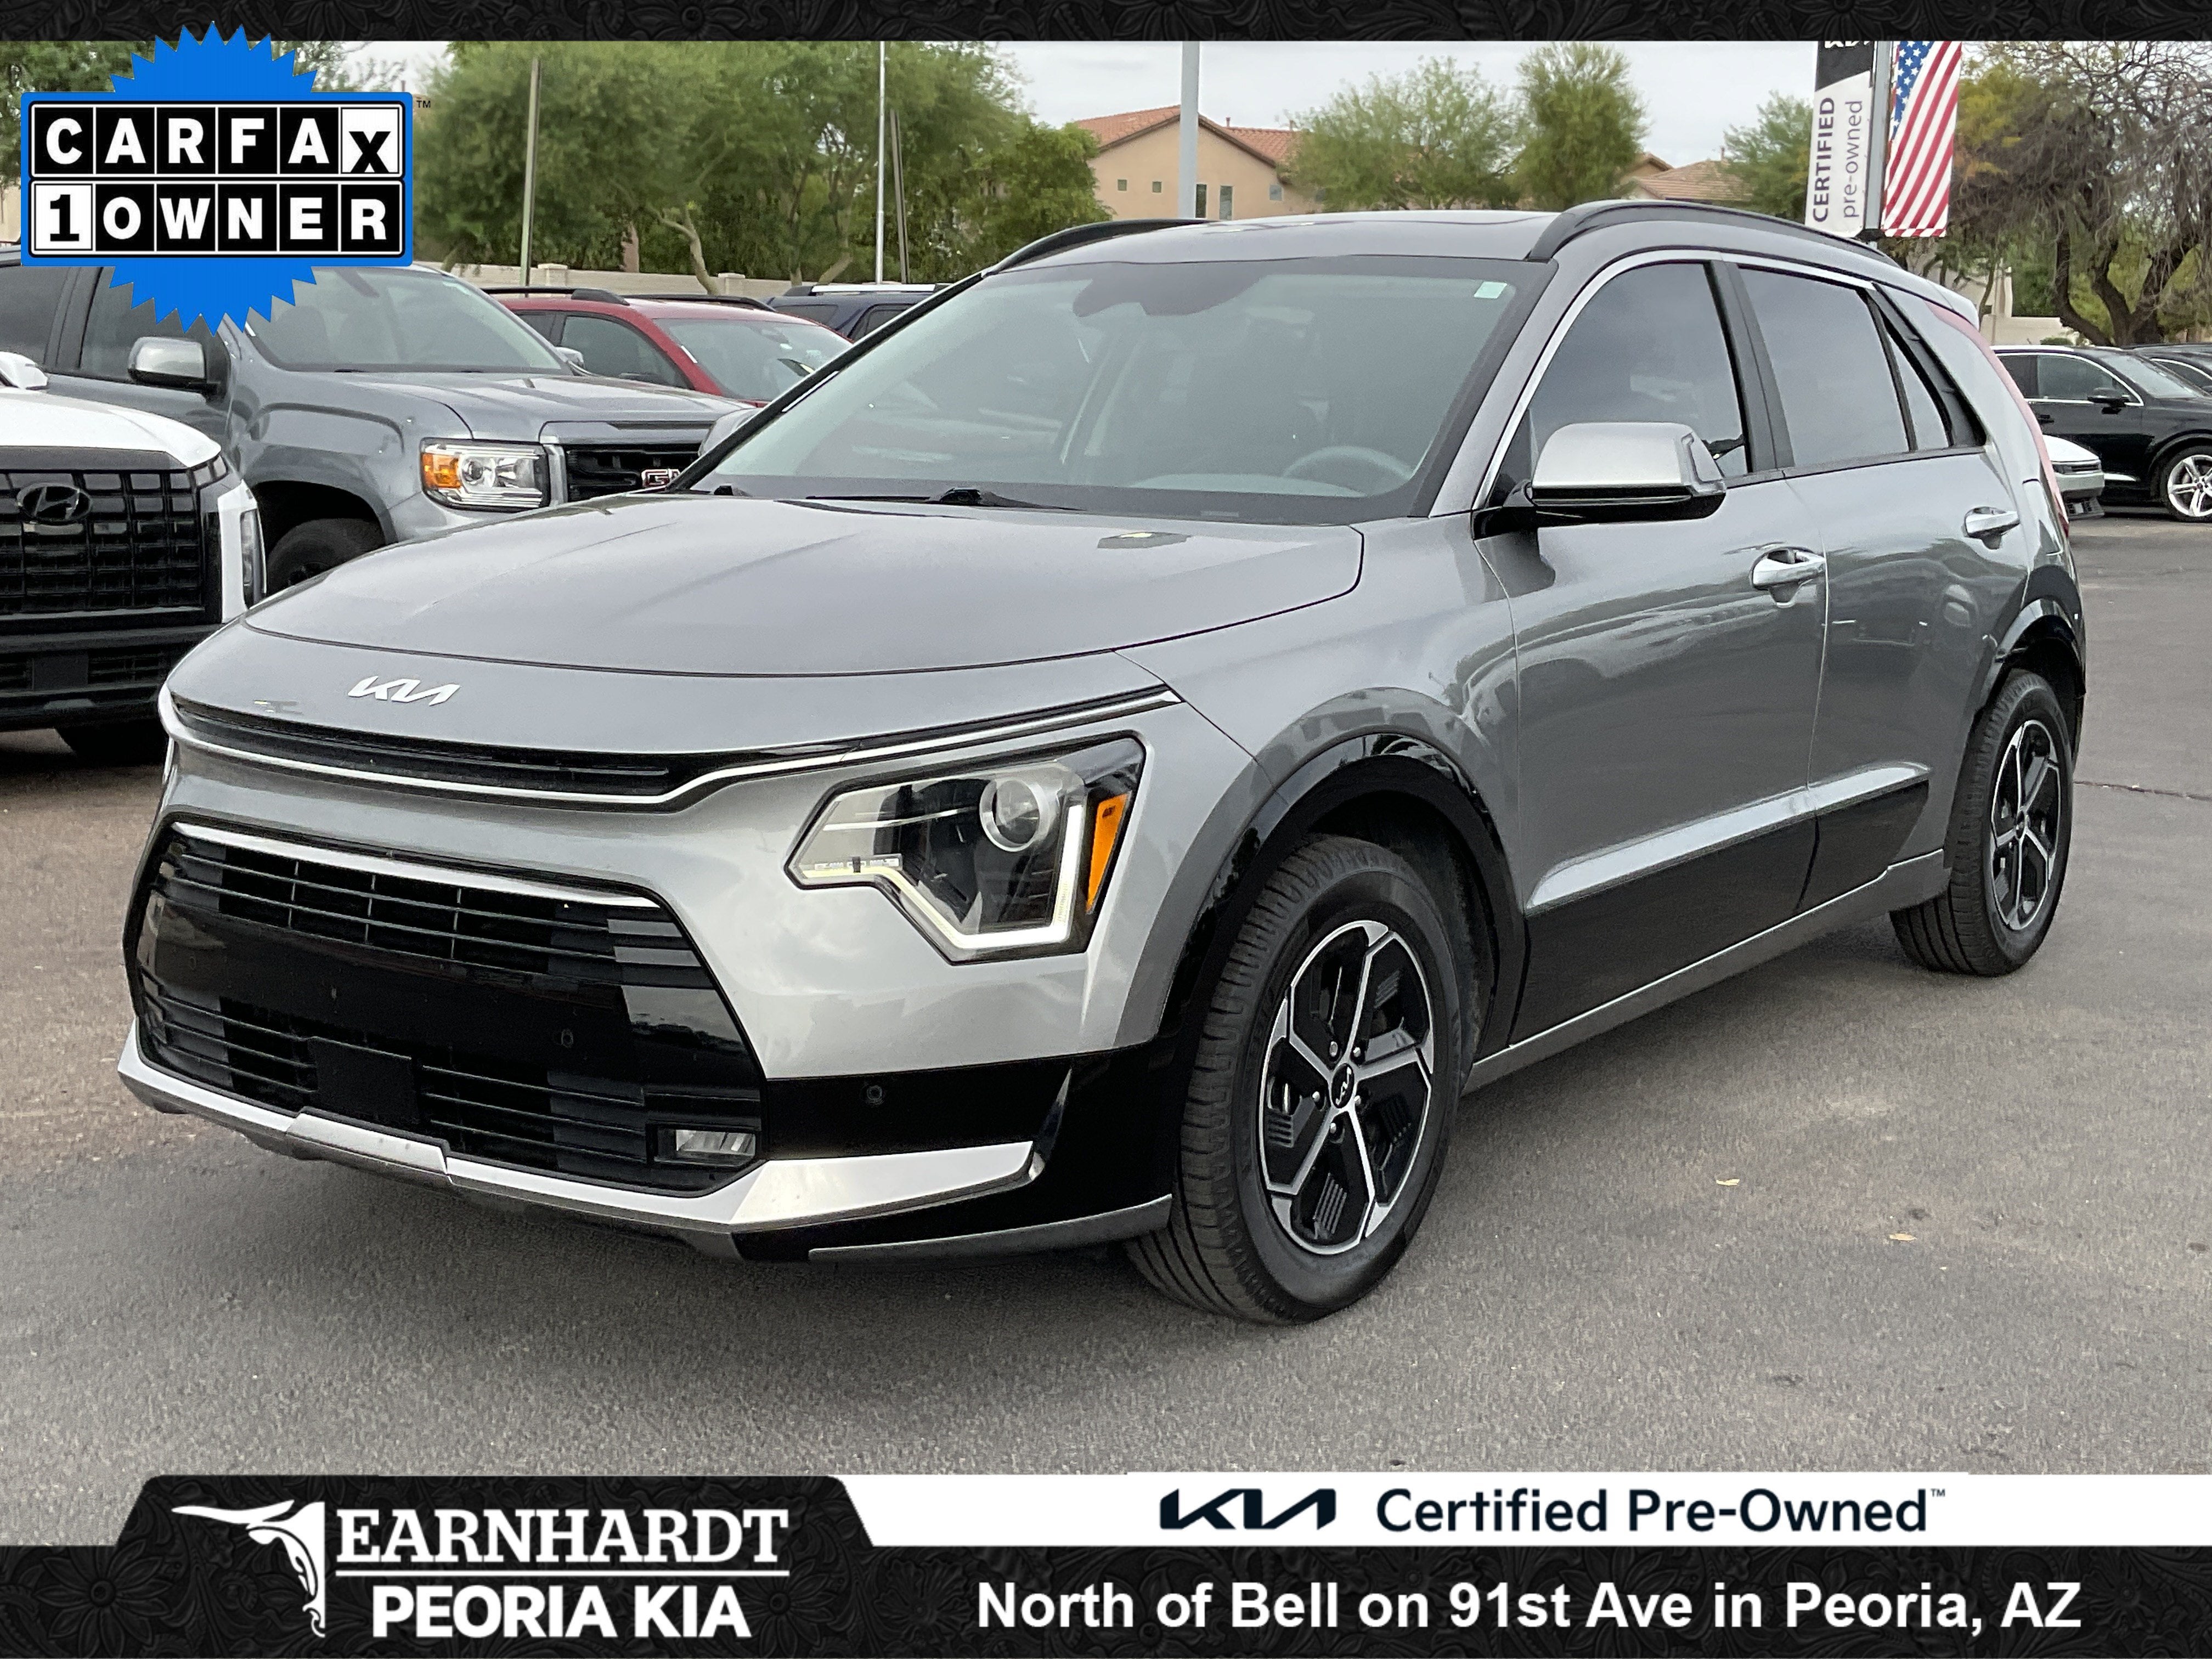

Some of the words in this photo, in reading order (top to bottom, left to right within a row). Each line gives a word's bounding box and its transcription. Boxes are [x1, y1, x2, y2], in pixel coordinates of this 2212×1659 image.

[1813, 97, 1835, 222] CERTIFIED
[1843, 100, 1863, 218] pre-owned
[347, 675, 461, 706] KIA
